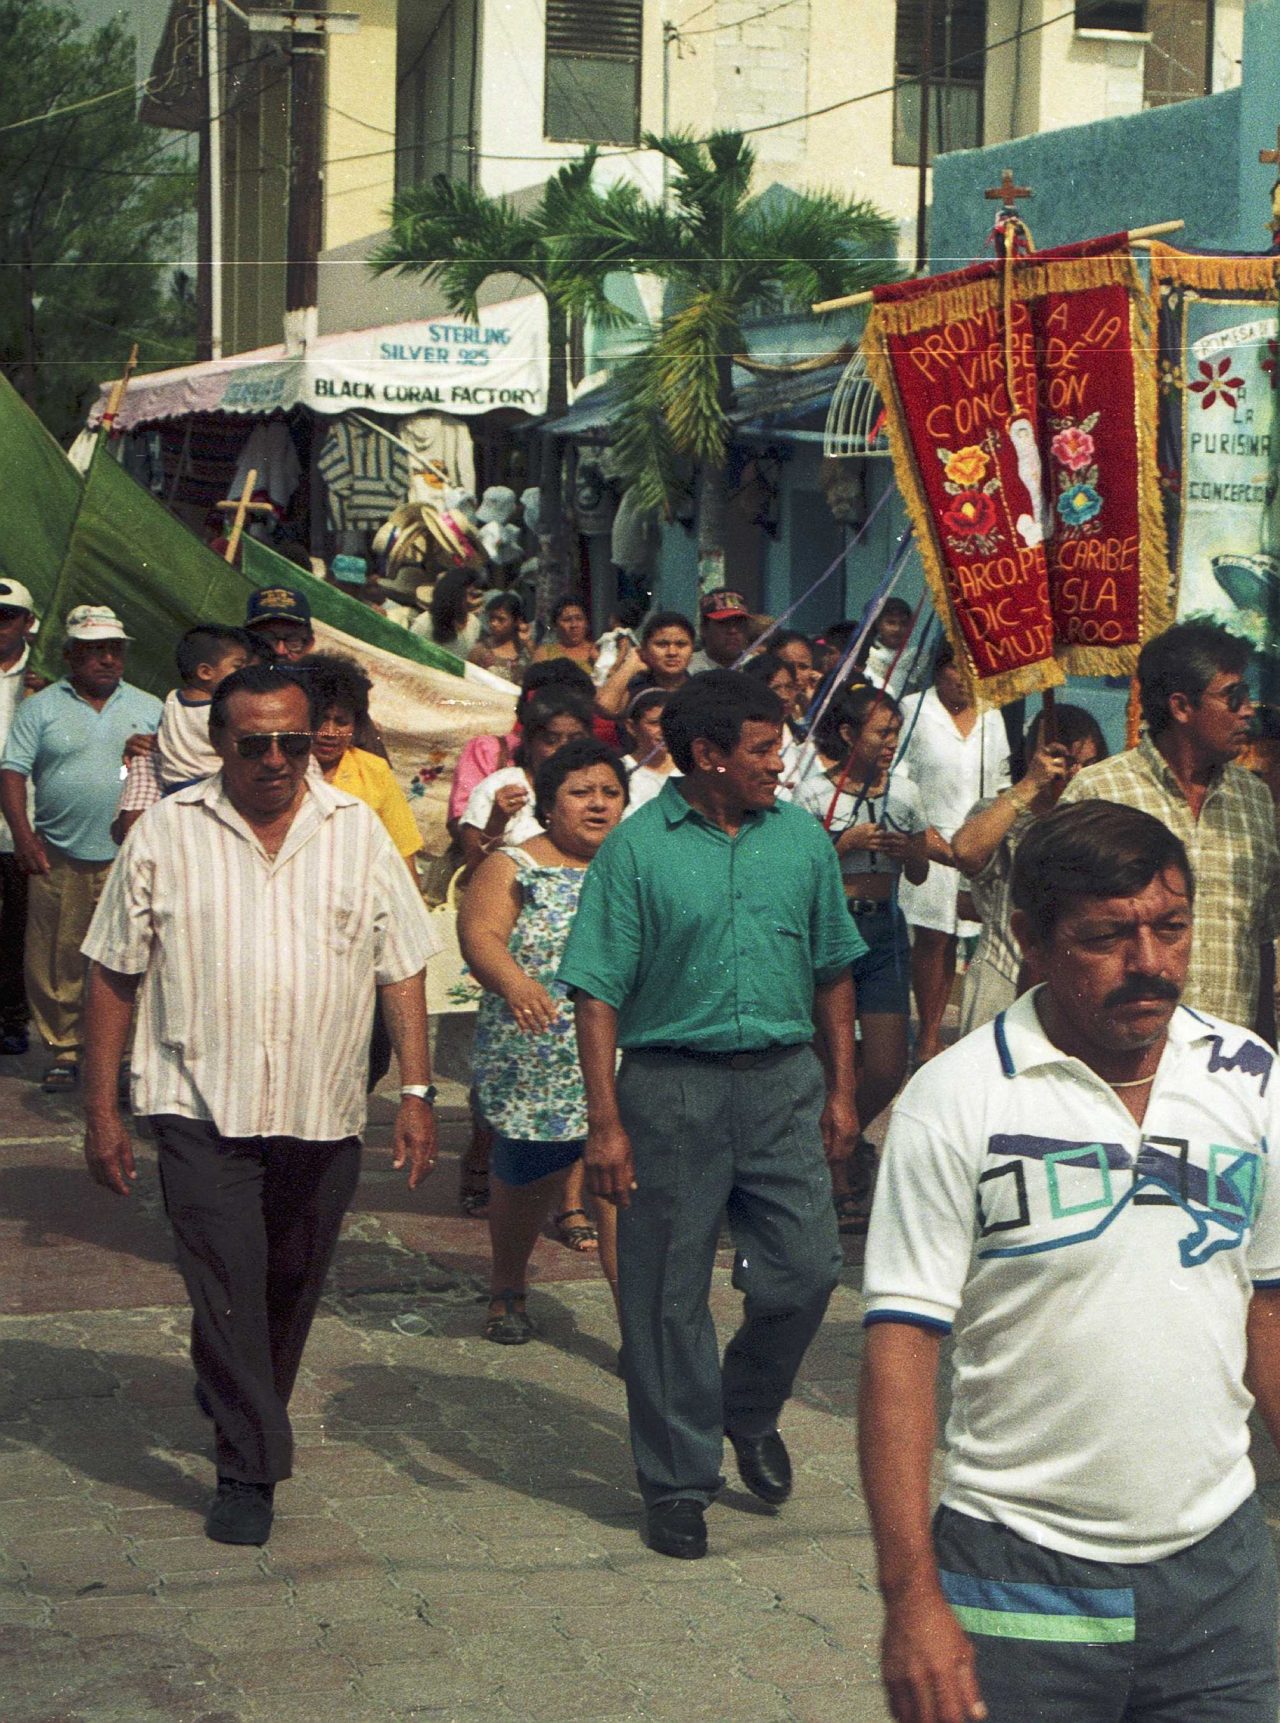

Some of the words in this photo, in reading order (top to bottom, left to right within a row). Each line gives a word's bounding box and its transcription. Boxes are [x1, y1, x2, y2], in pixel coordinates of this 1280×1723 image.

[429, 324, 511, 345] STERLING
[380, 343, 449, 364] SILVER
[1046, 337, 1086, 369] DE
[315, 378, 375, 400] BLACK
[383, 384, 445, 402] CORAL
[451, 386, 540, 405] FACTORY
